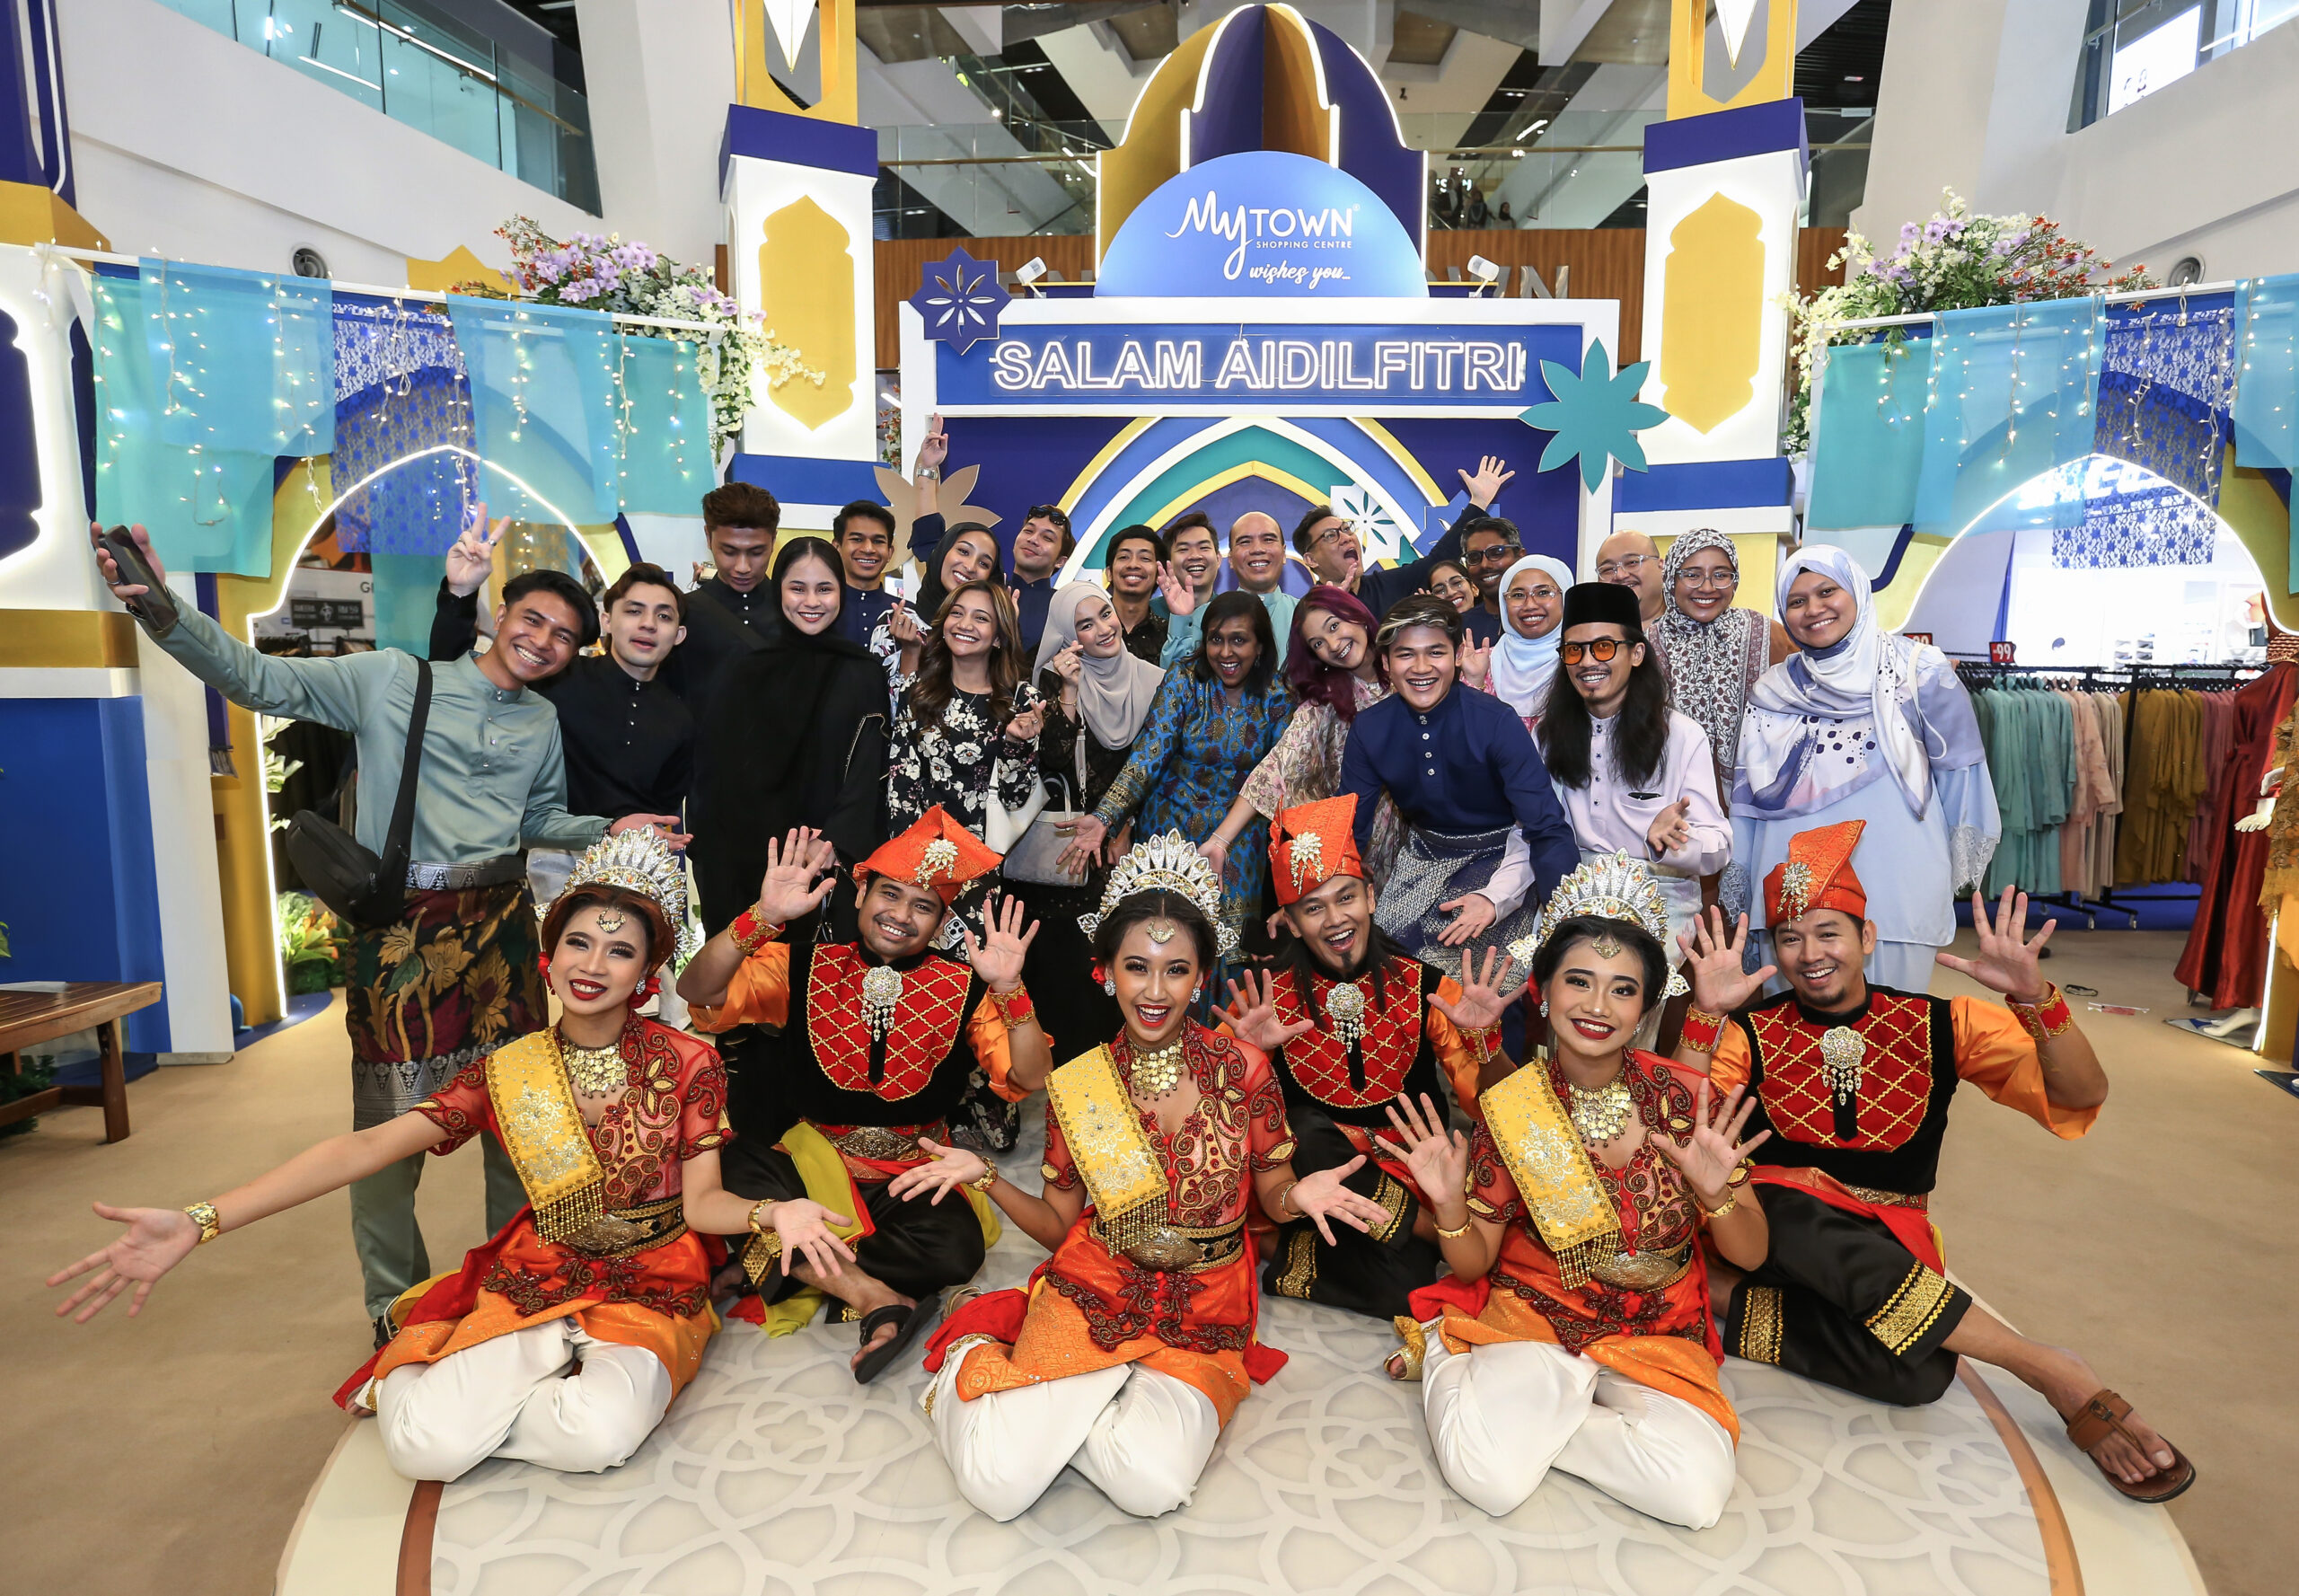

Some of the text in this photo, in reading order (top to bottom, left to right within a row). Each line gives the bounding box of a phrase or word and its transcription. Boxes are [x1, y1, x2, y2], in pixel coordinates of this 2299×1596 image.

[1255, 241, 1352, 249] SHOPPING CENTRE
[1249, 260, 1309, 285] wishes
[993, 340, 1523, 391] SALAM AIDILFITRI
